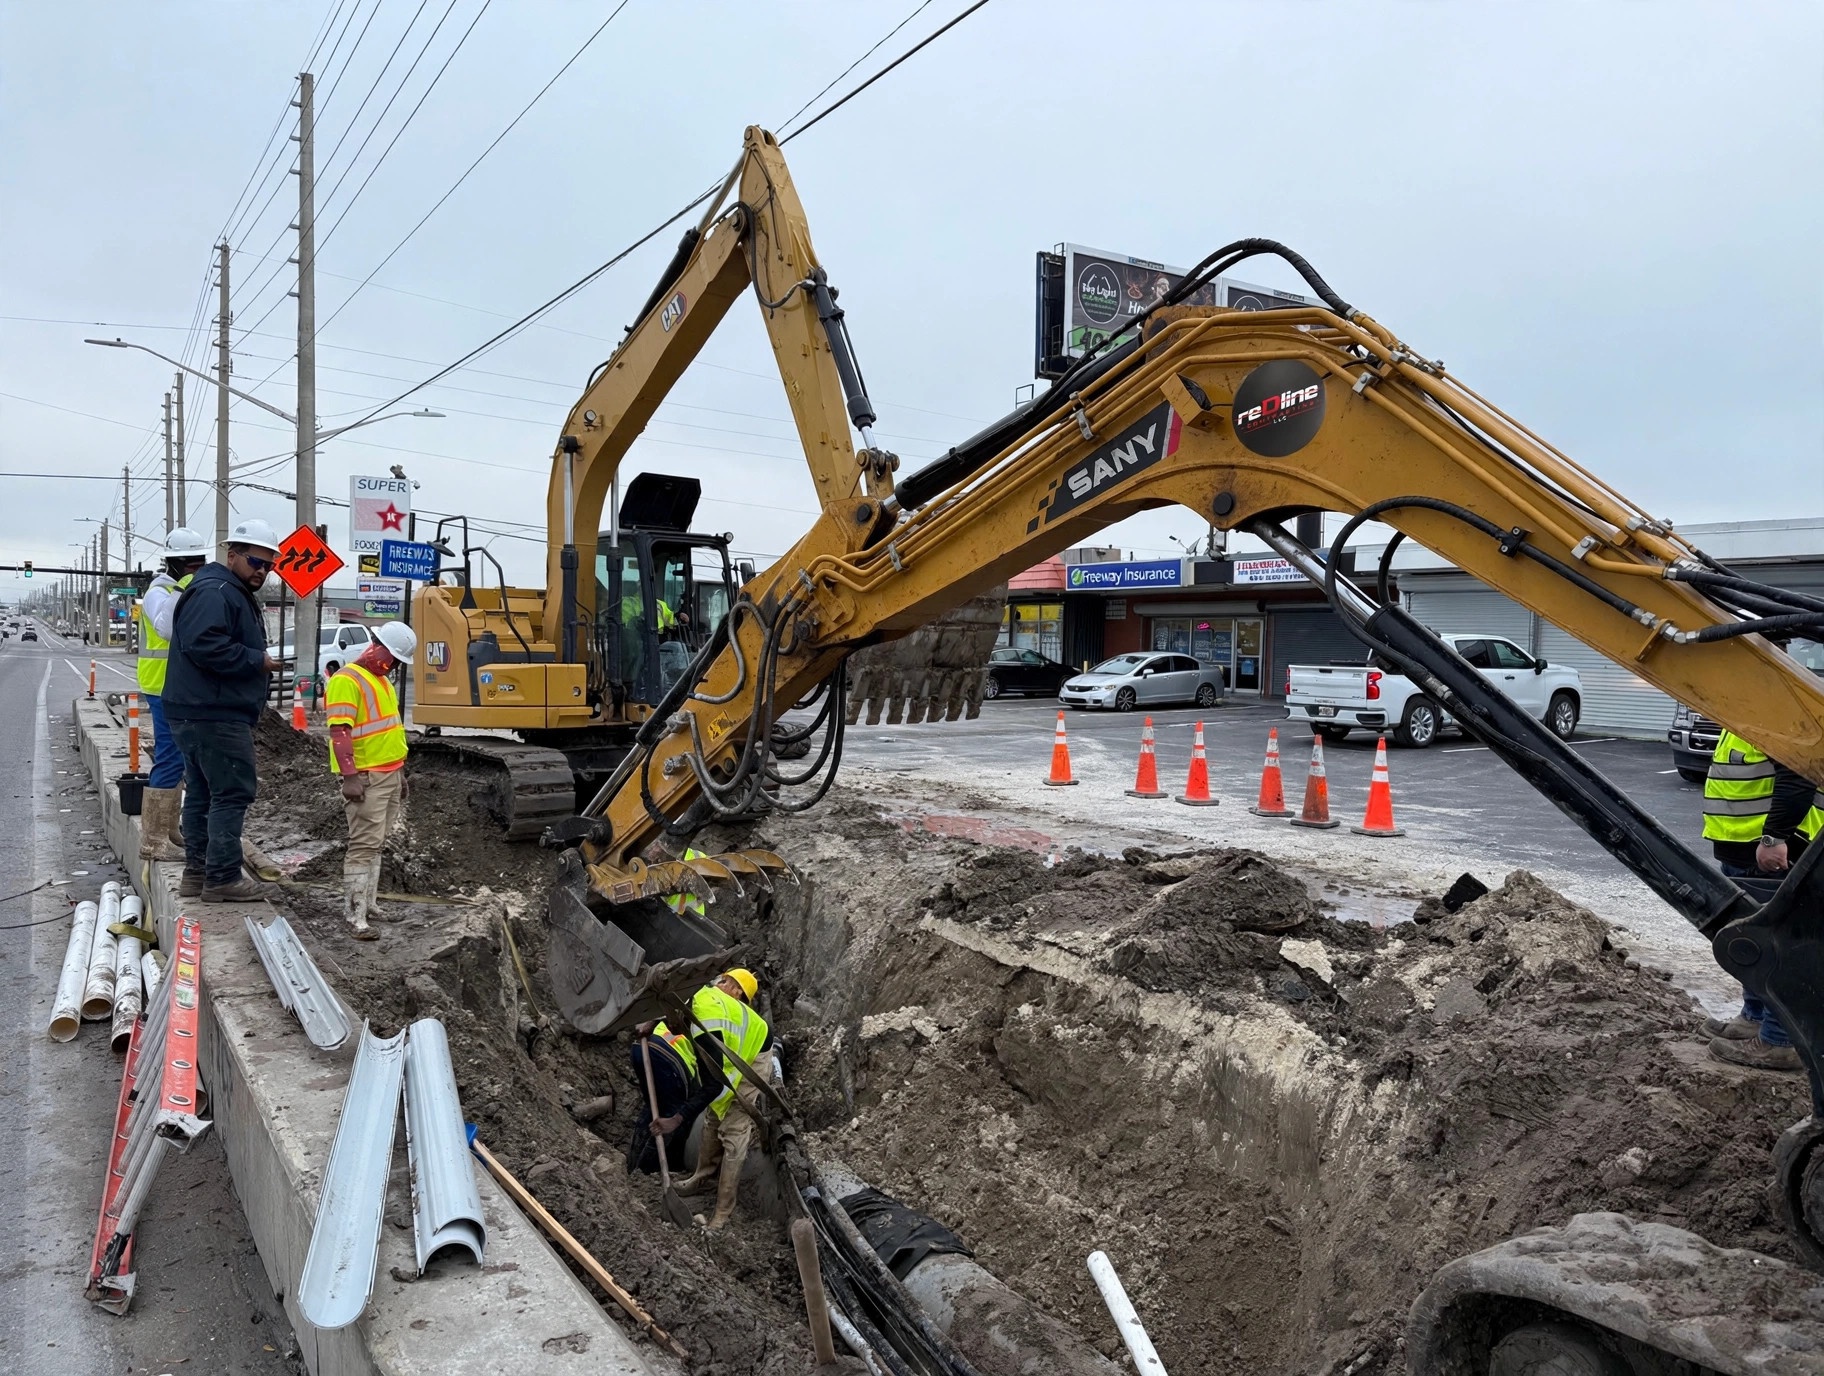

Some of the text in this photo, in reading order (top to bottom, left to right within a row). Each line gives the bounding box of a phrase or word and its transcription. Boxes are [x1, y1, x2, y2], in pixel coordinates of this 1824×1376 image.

[661, 293, 682, 332] CAT
[1067, 422, 1157, 499] SANY
[357, 478, 407, 493] SUPER
[1081, 567, 1176, 586] Freeway Insurance
[426, 641, 445, 666] CAT
